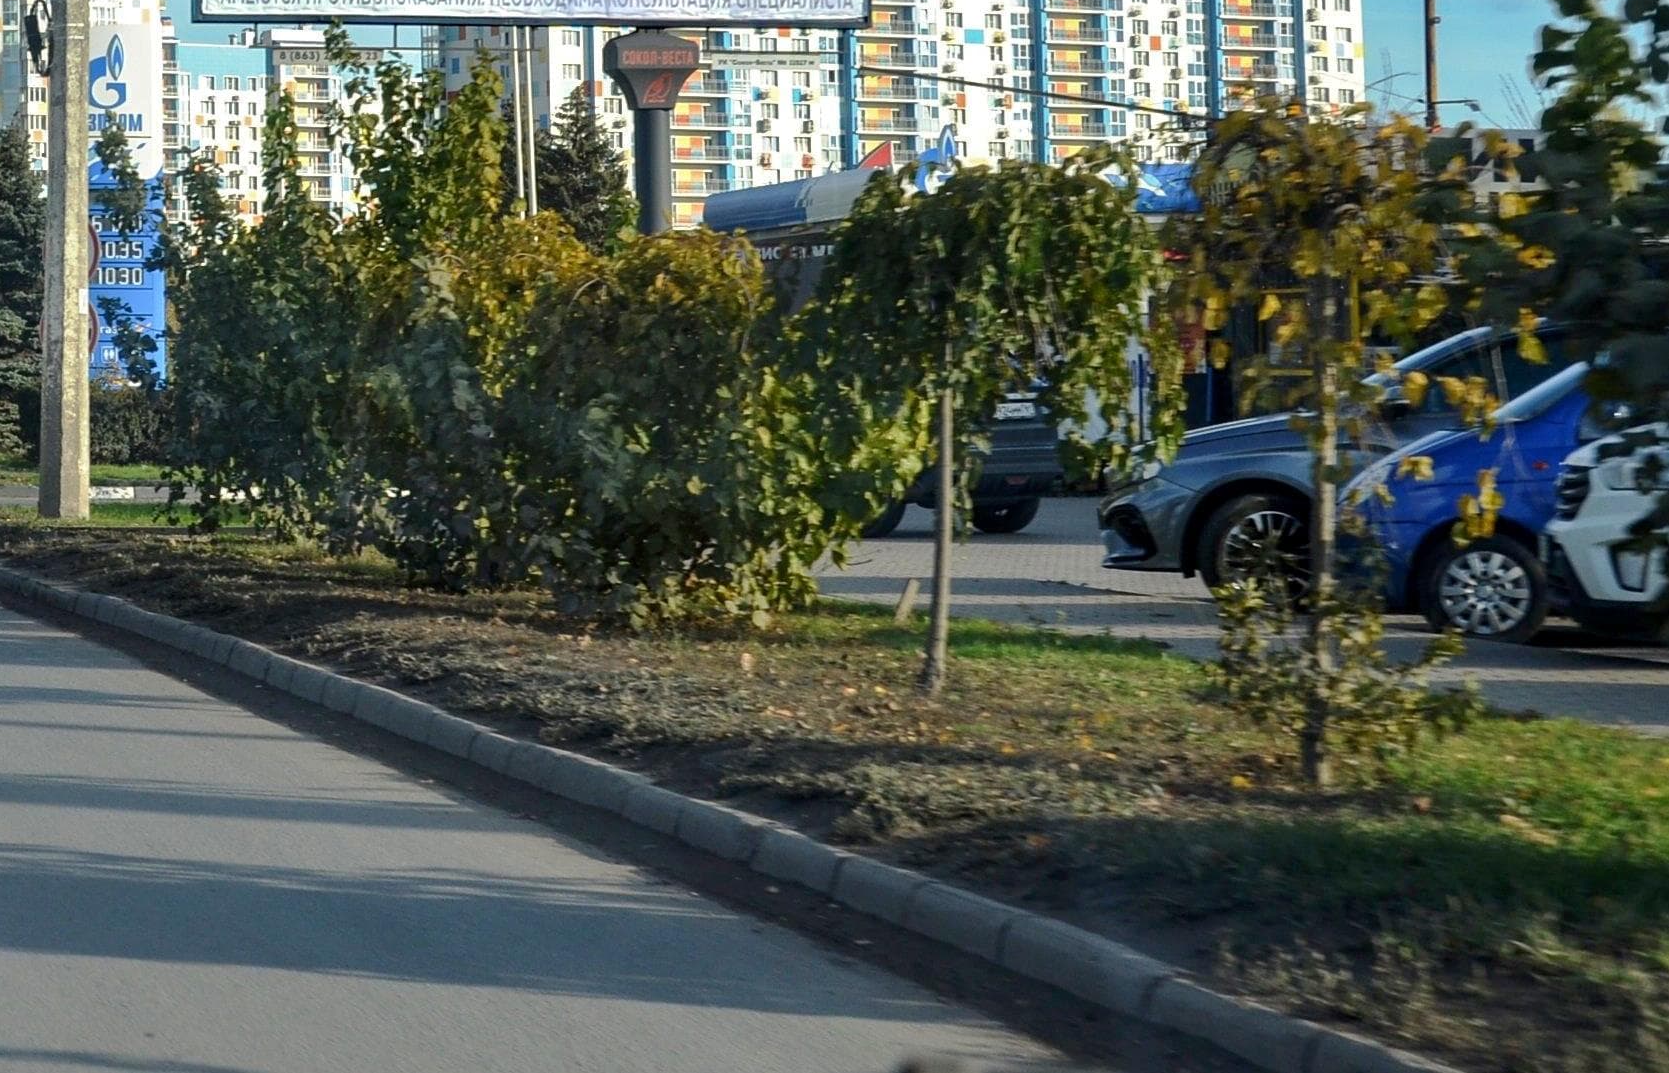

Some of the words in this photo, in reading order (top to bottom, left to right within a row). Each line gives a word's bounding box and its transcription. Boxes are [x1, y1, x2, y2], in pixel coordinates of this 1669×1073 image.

[279, 51, 286, 59] 8
[290, 51, 320, 61] (863)
[622, 50, 694, 65] СОКОЛ-ВЕСТА
